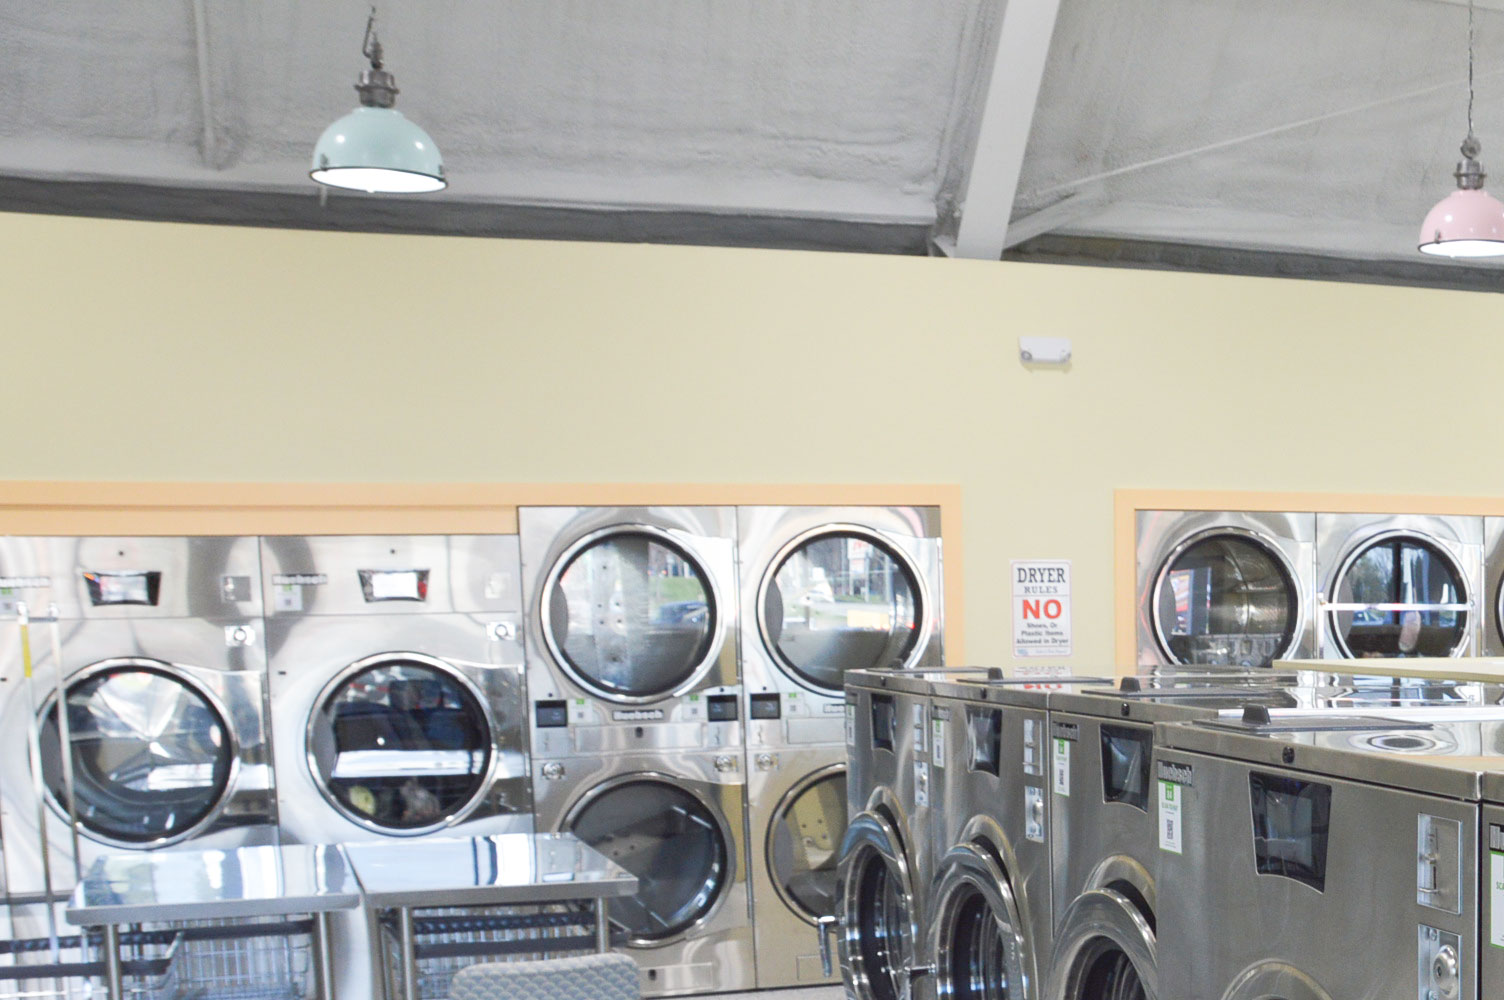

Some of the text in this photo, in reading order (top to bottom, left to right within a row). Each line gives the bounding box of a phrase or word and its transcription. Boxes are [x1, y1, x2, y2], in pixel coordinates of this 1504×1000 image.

[1017, 567, 1066, 583] DRYER
[1024, 585, 1058, 594] RULES
[1022, 599, 1062, 620] NO
[1051, 637, 1069, 646] Dryer
